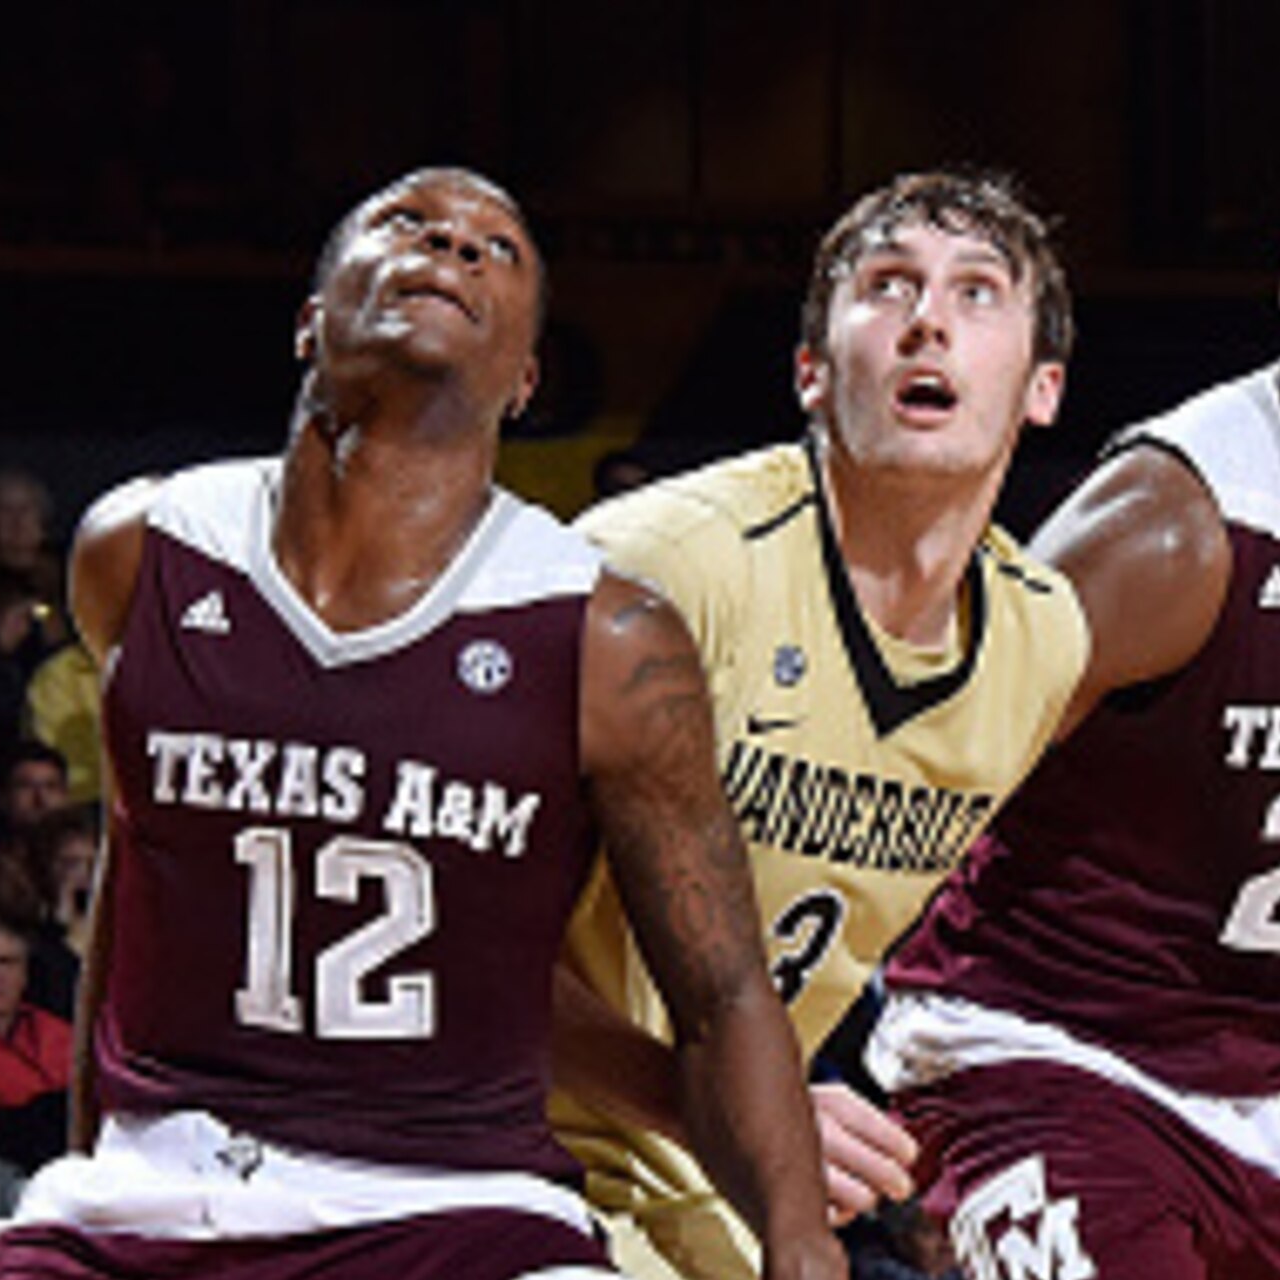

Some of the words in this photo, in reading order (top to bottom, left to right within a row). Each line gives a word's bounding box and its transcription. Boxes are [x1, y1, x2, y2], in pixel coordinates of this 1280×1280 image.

[146, 731, 366, 822] TEXAS
[382, 760, 541, 858] A&M
[233, 825, 436, 1041] 12
